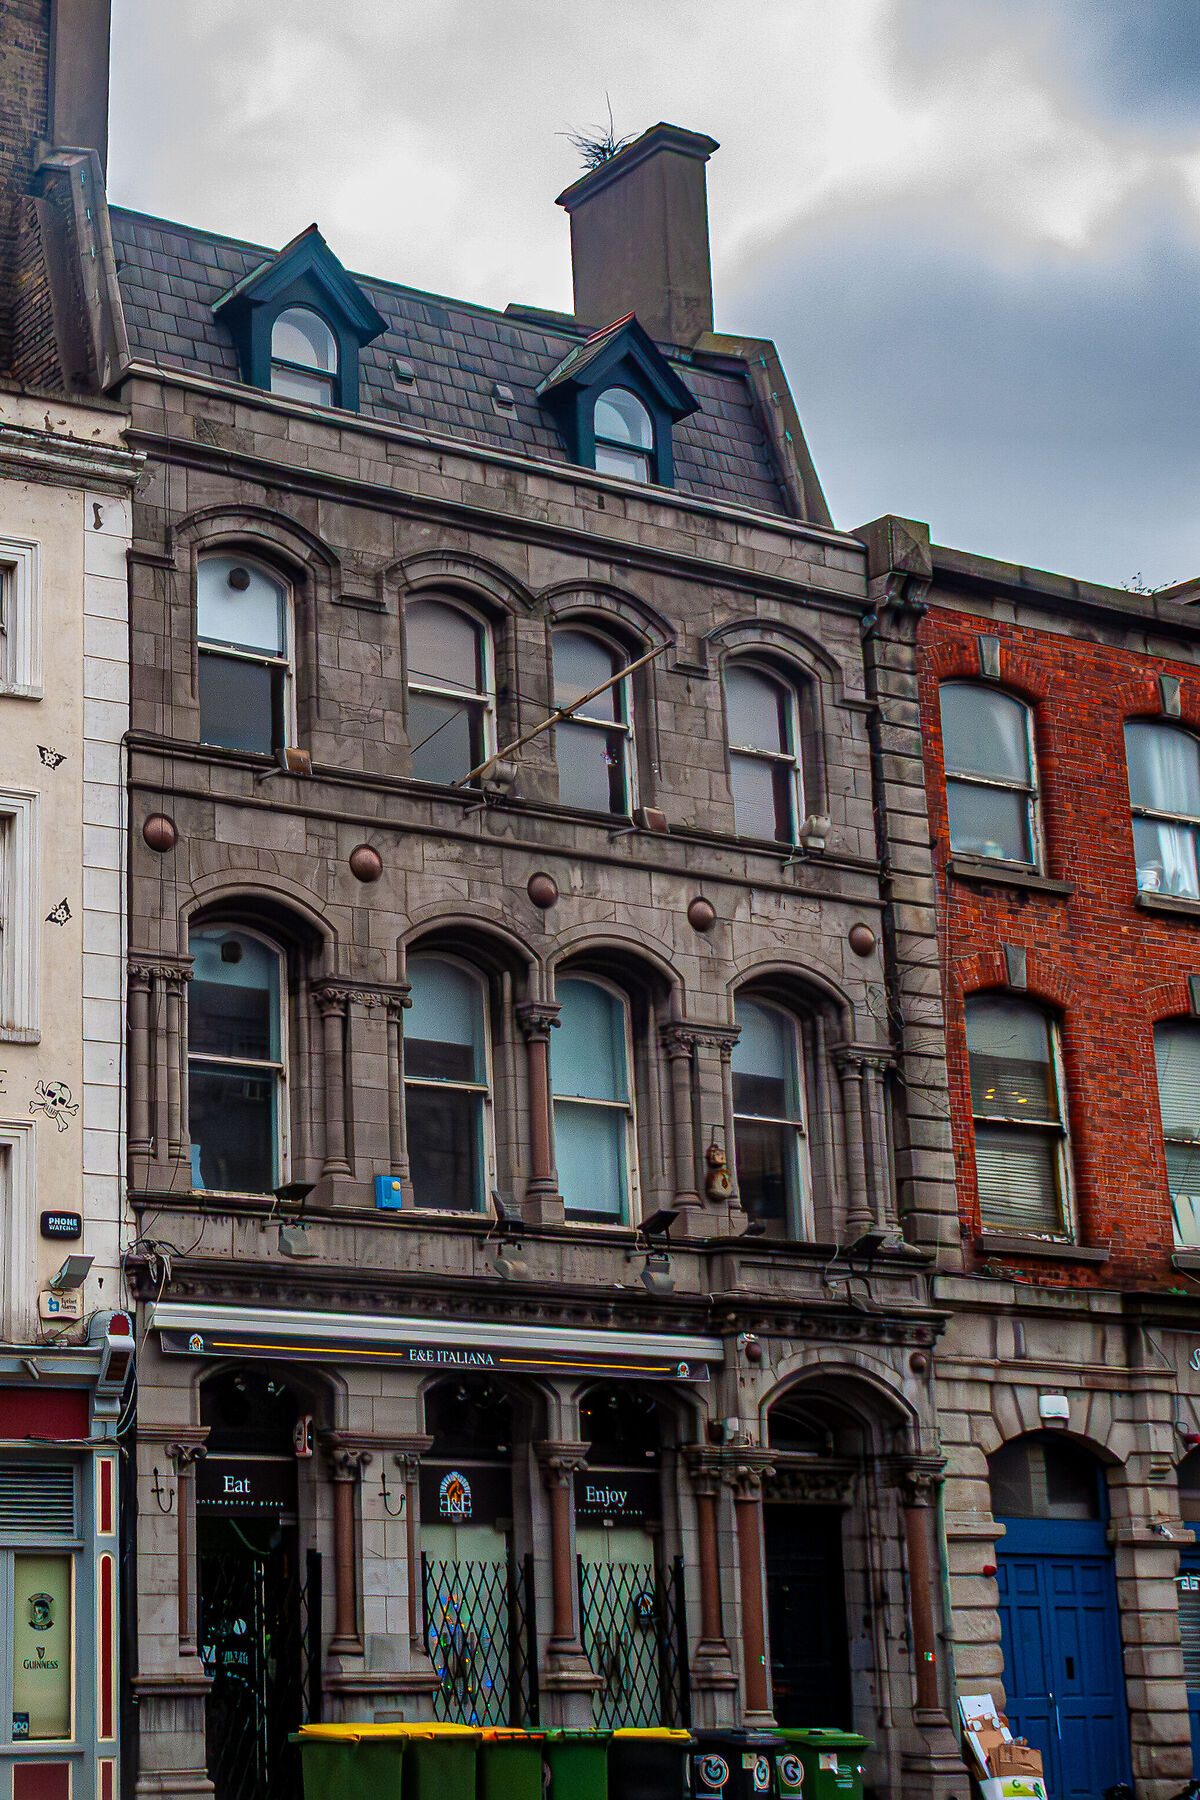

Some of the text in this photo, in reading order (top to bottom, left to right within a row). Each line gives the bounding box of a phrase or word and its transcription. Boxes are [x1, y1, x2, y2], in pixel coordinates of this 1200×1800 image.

[48, 1217, 78, 1226] PHONE
[409, 1349, 495, 1366] E&E ITALIANA
[223, 1475, 251, 1493] Eat
[585, 1486, 628, 1507] Enjoy
[23, 1658, 59, 1670] GUINNESS
